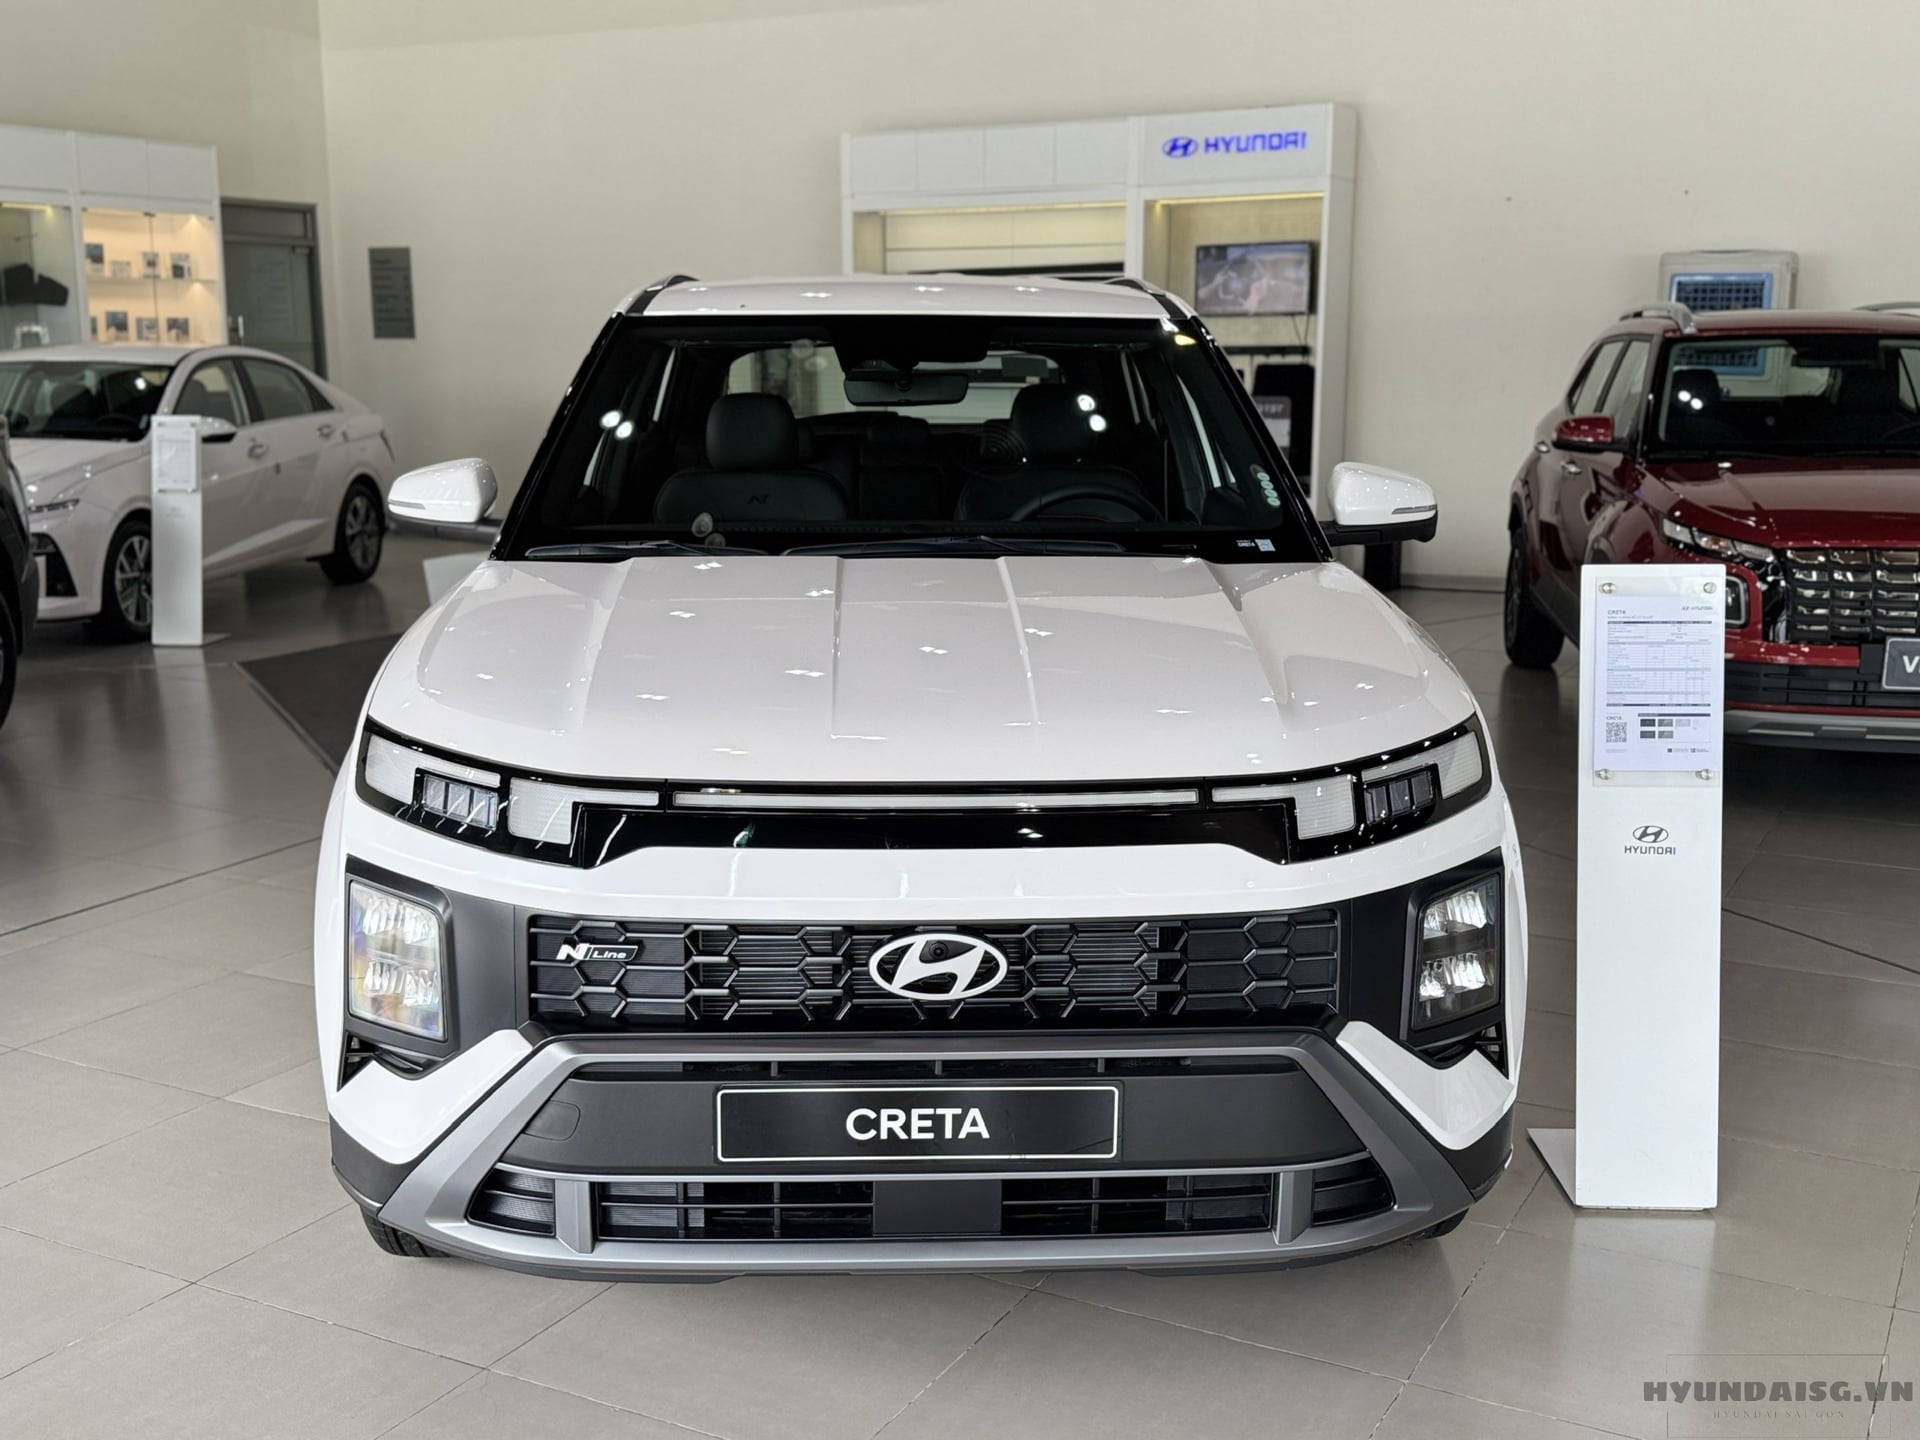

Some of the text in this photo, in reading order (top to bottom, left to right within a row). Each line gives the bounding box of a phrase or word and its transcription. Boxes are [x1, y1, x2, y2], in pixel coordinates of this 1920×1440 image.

[1204, 131, 1307, 153] HYUNDAI
[1902, 655, 1920, 673] V
[1624, 845, 1676, 855] HYUNDAI
[556, 943, 627, 960] N Line
[845, 1107, 990, 1140] CRETA
